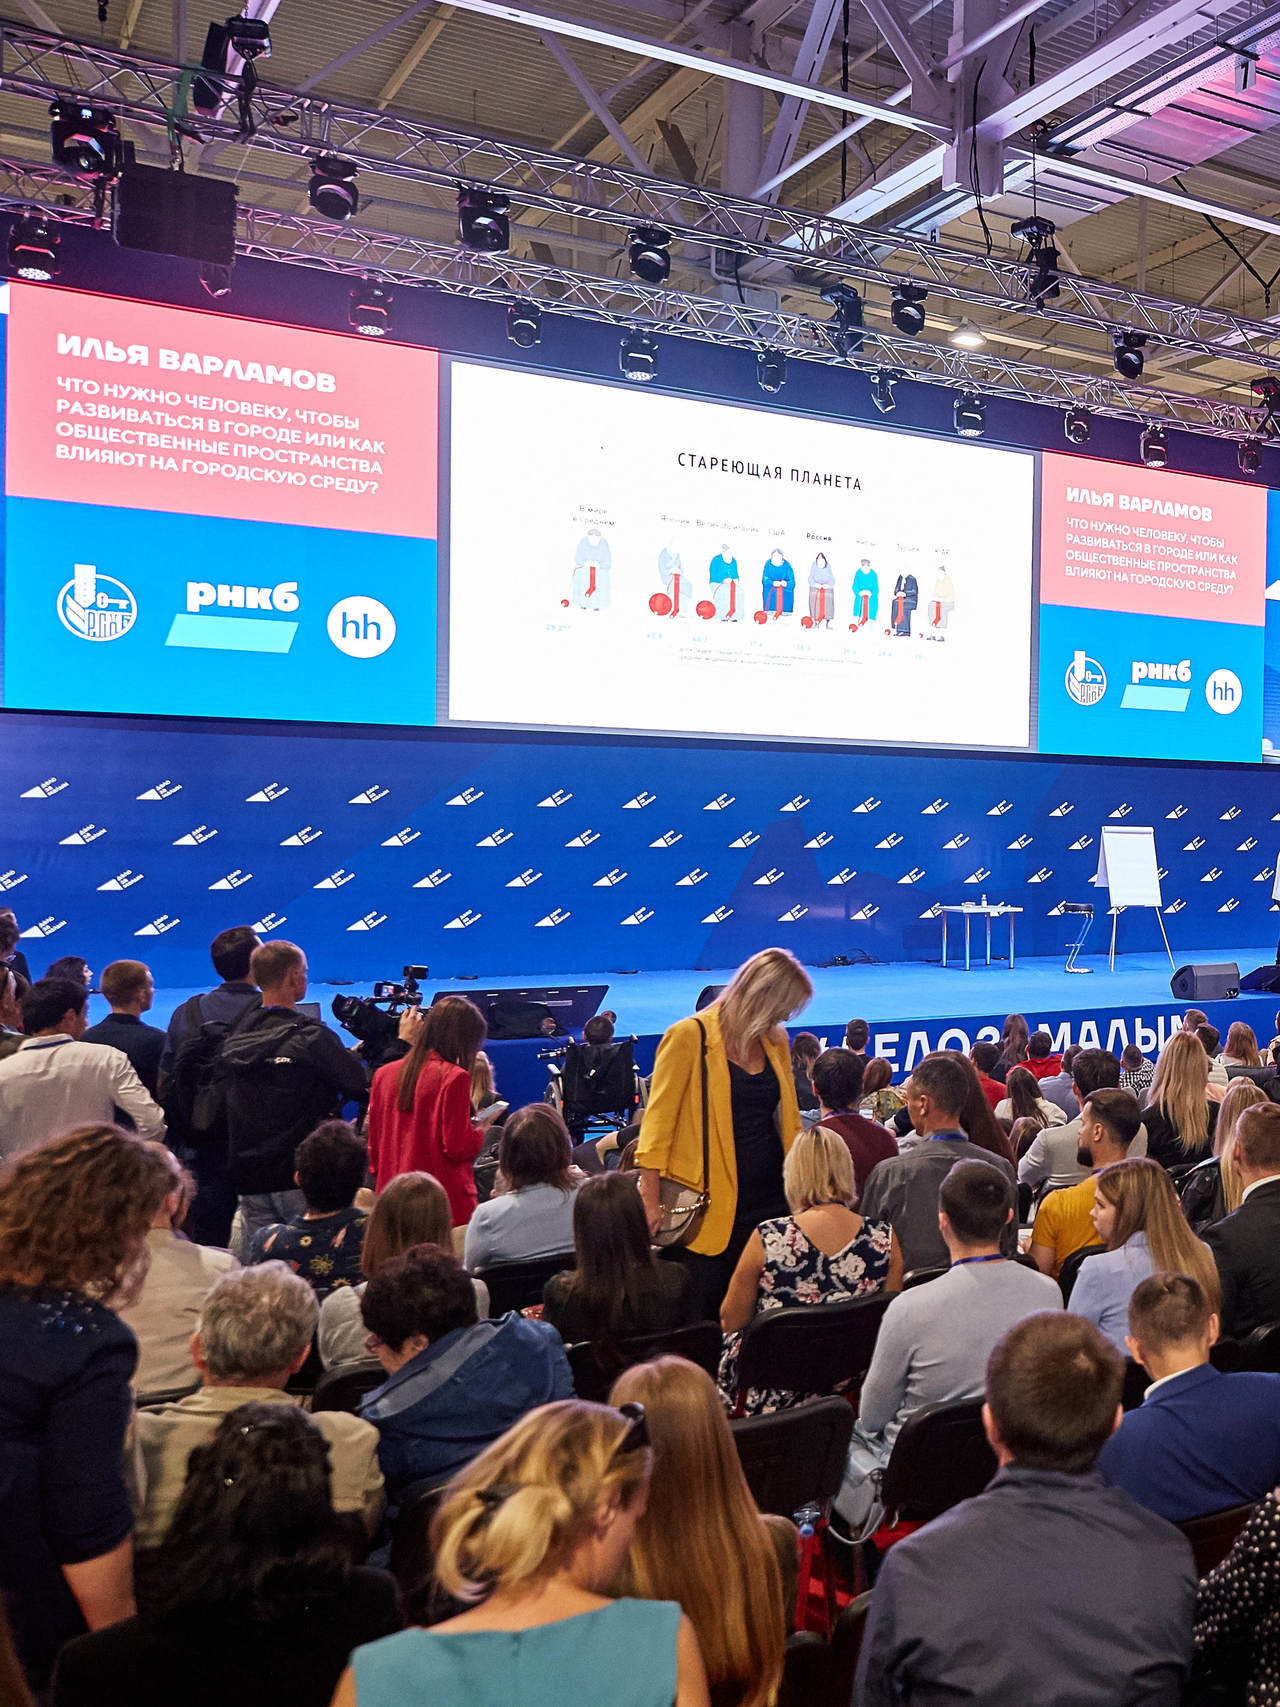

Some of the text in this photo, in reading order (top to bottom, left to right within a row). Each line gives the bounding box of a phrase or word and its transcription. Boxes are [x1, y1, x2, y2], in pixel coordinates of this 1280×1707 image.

[57, 333, 337, 393] ИЛЬЯ ВАРЛАМОВ
[57, 376, 360, 430] ЧТО НУЖНО ЧЕЛОВЕКУ, ЧТОБЫ
[56, 399, 387, 455] РАЗВИВАТЬСЯ В ГОРОДЕ ИЛИ КАК
[56, 421, 383, 475] ОБЩЕСТВЕННЫЕ ПРОСТРАНСТВА
[56, 445, 379, 496] ВЛИЯЮТ НА ГОРОДСКУЮ СРЕДУ?
[677, 452, 863, 492] СТАРЕЮЩАЯ ПЛАНЕТА
[1066, 486, 1213, 522] ИЛЬЯ ВАРЛАМОВ
[806, 532, 832, 542] Россия
[1066, 517, 1225, 548] ЧТО НУЖНО ЧЕЛОВЕКУ, ЧТОБЫ
[1065, 550, 1237, 580] ОБЩЕСТВЕННЫЕ ПРОСТРАНСТВА
[1066, 533, 1239, 566] РАЗВИВАТЬСЯ В ГОРОДЕ ИЛИ КАК
[186, 580, 300, 613] рнкб
[1065, 566, 1234, 596] ВЛИЯЮТ НА ГОРОДСКУЮ СРЕДУ?
[341, 612, 382, 642] hh
[1131, 660, 1192, 684] рнкб
[1213, 681, 1235, 701] hh
